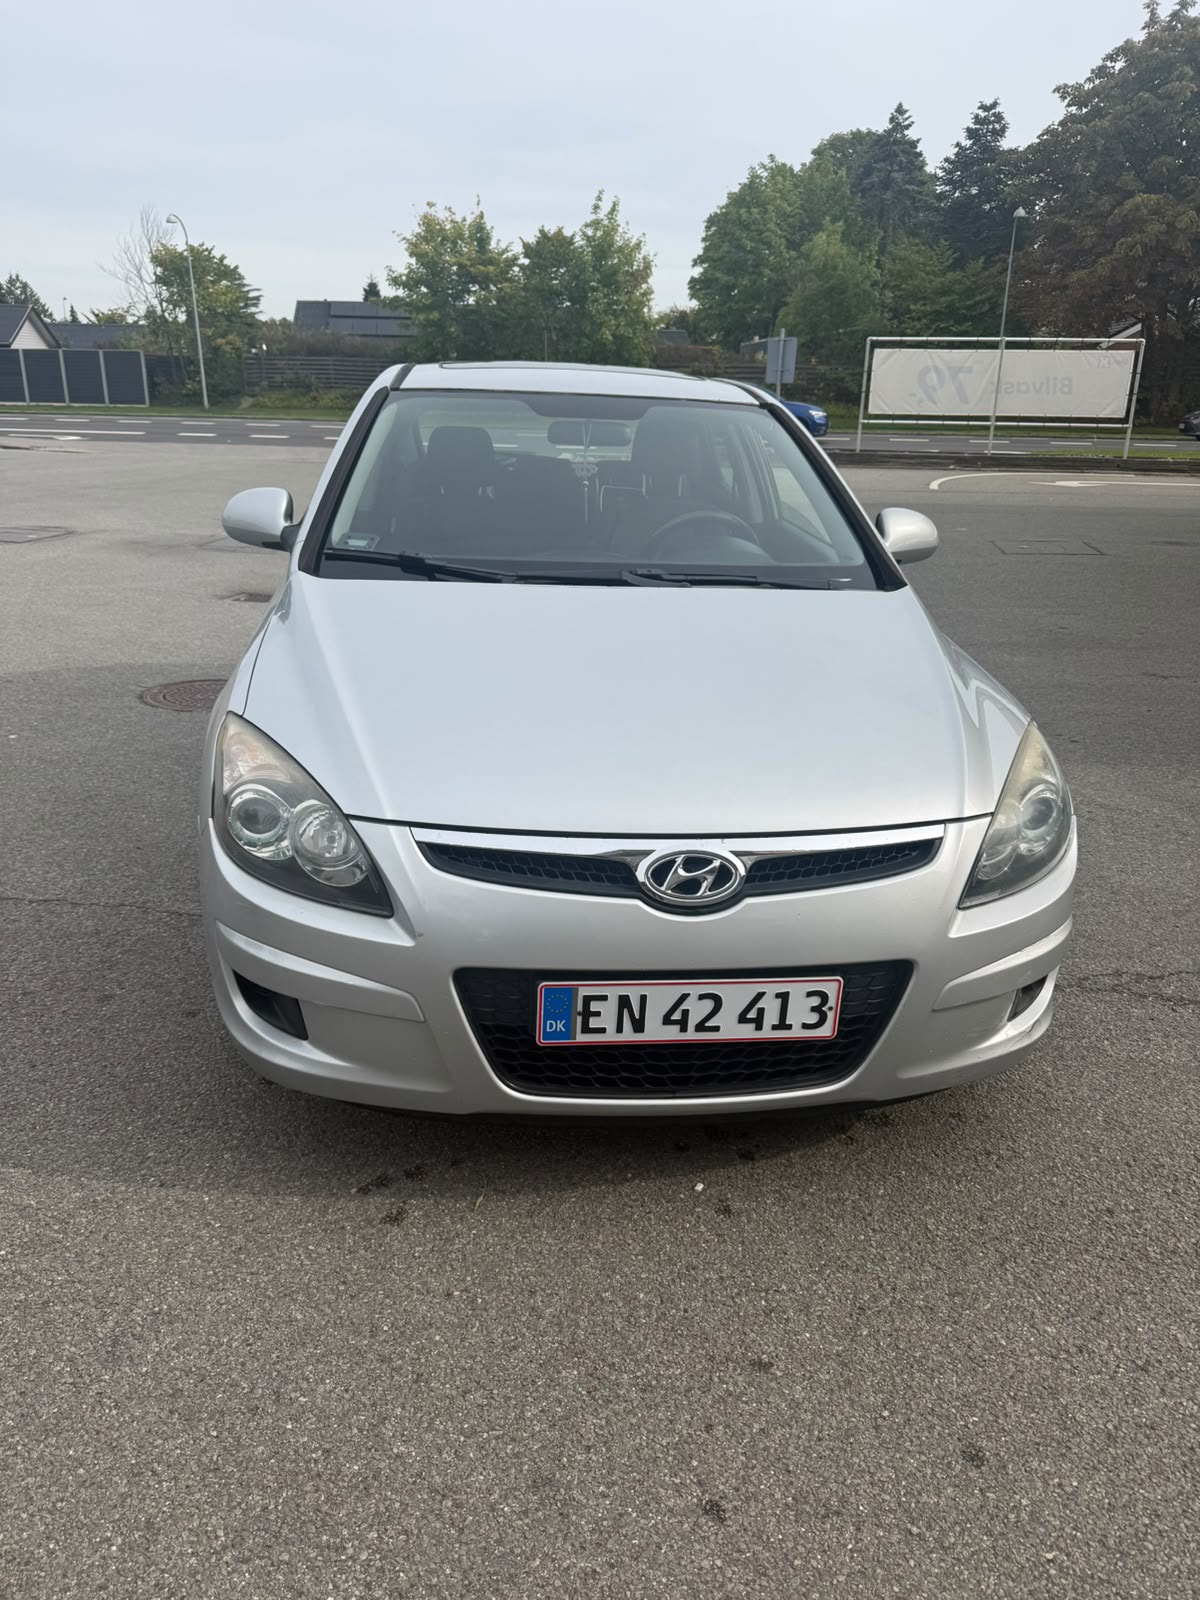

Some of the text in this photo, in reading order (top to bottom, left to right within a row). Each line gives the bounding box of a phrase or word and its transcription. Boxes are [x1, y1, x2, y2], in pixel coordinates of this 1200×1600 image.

[546, 1019, 567, 1033] DK
[580, 989, 831, 1034] EN 42 413
